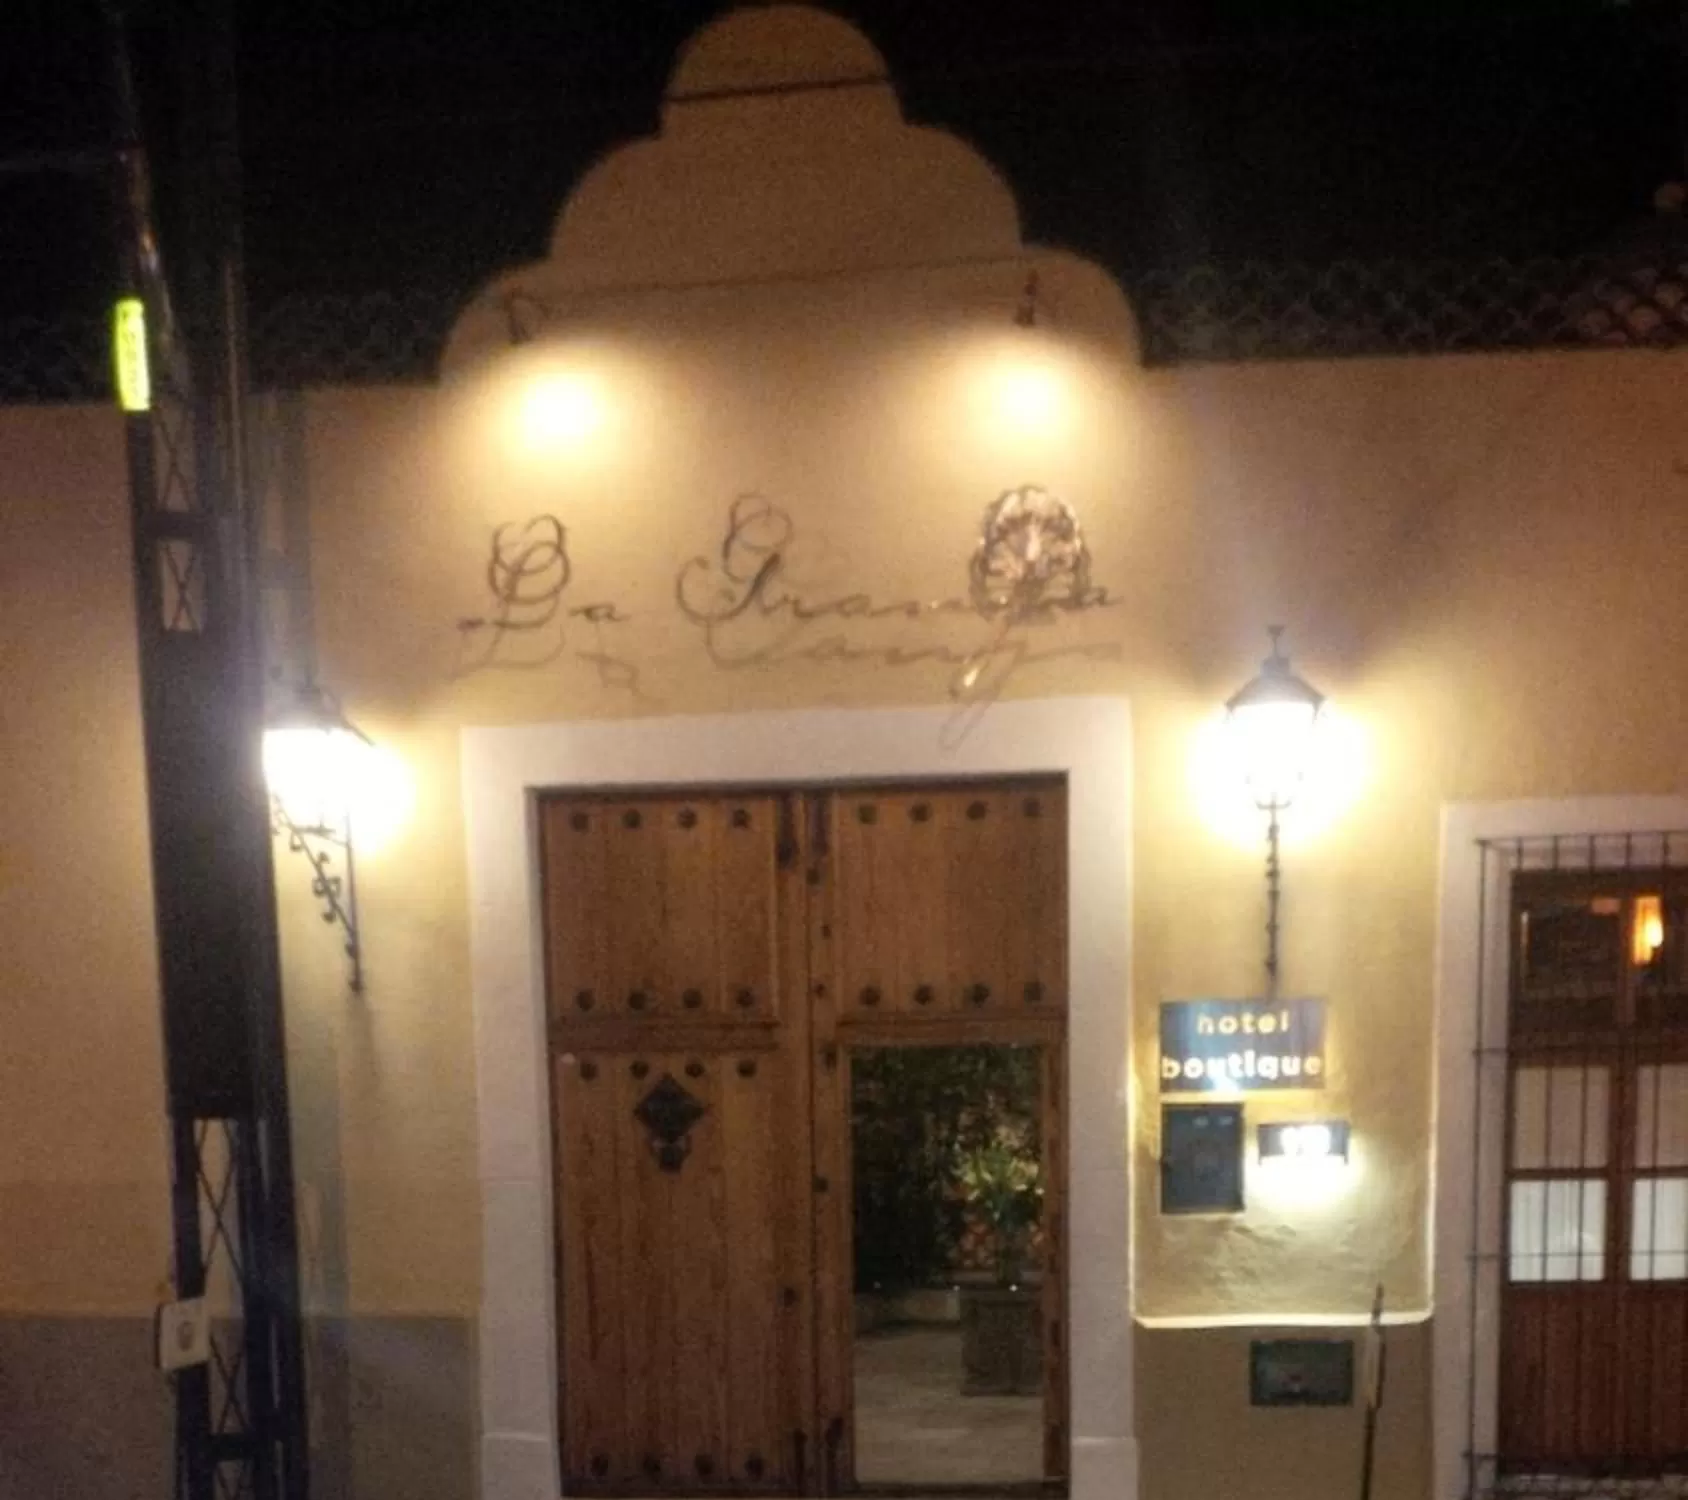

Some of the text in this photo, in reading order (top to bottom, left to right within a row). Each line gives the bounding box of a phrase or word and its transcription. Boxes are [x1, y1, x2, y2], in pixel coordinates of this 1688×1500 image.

[456, 511, 634, 630] La
[1197, 1008, 1290, 1036] hotel
[1161, 1048, 1322, 1081] boutique
